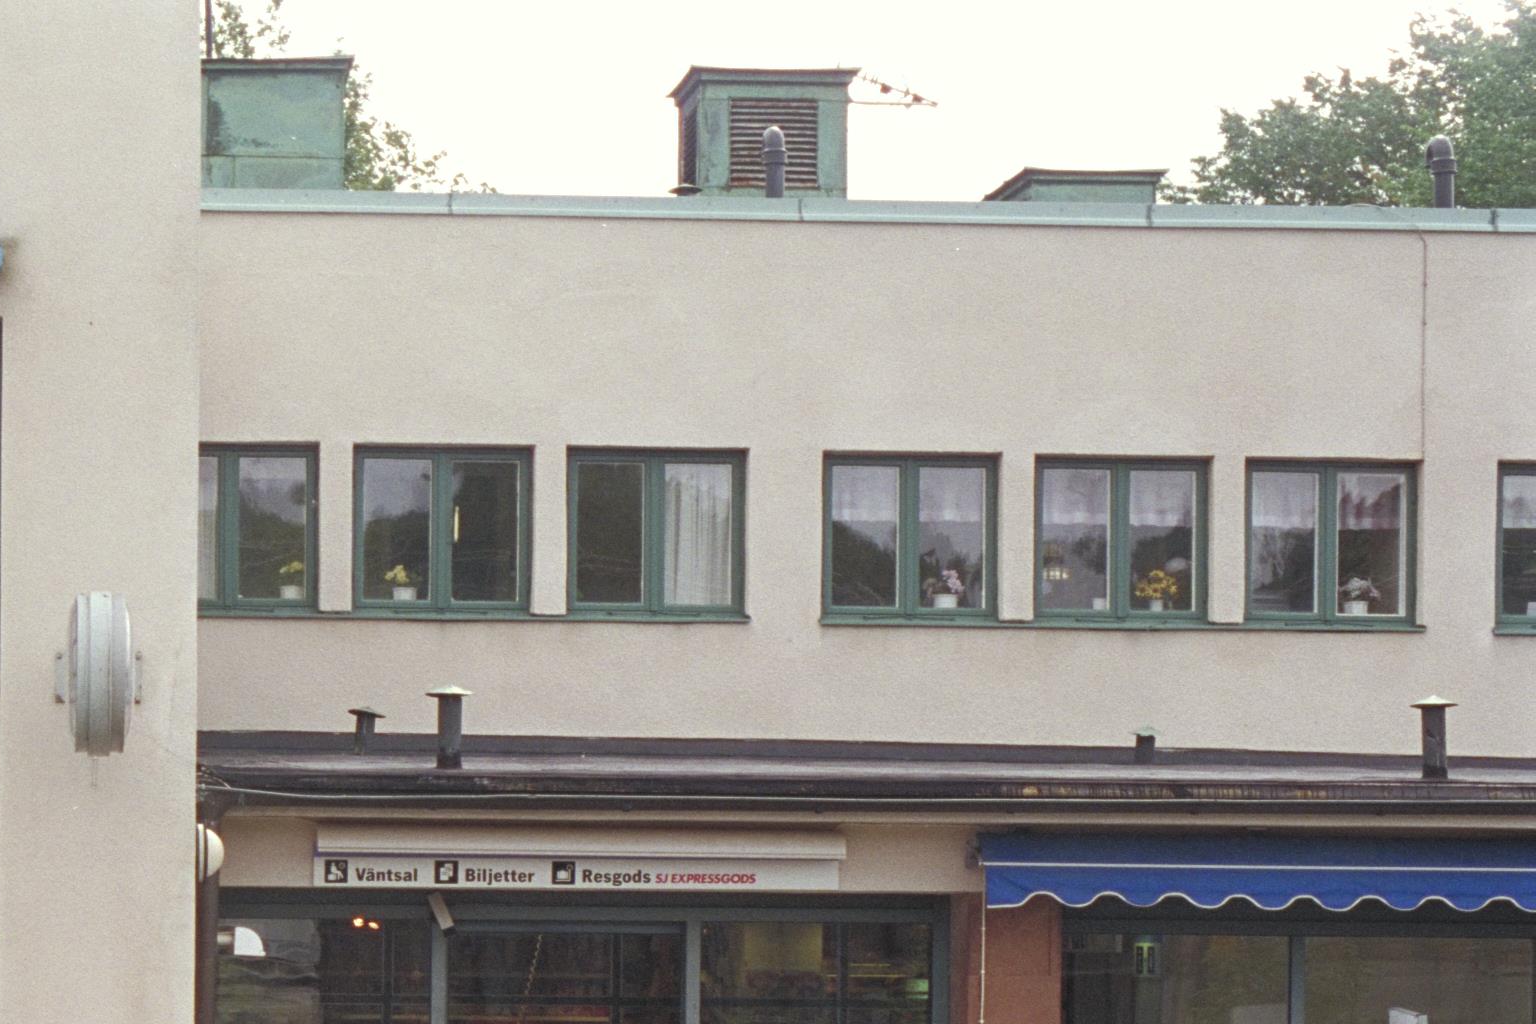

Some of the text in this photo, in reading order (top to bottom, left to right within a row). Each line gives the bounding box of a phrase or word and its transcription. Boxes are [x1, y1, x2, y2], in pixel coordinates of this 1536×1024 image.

[355, 867, 757, 887] Väntsal Biljetter Resgods SJ EXPRESSGODS
